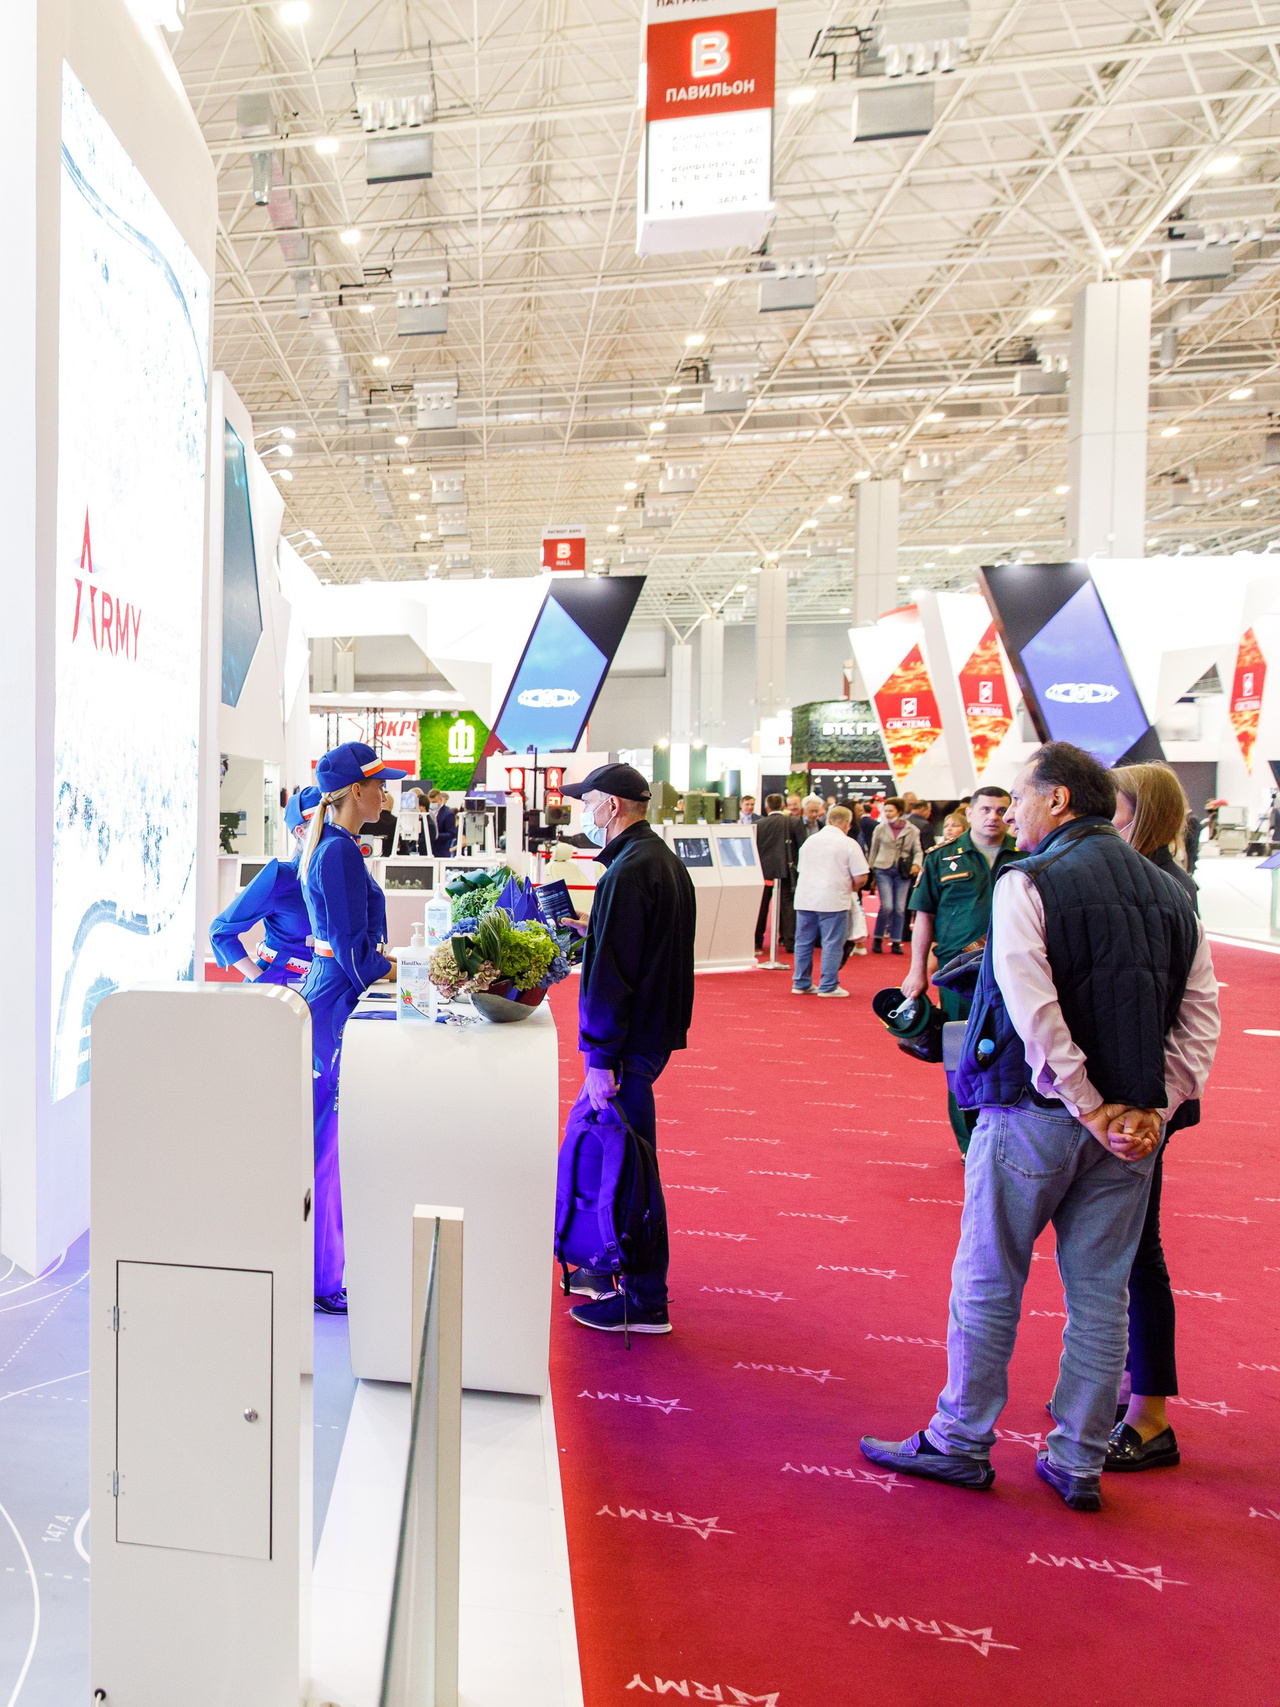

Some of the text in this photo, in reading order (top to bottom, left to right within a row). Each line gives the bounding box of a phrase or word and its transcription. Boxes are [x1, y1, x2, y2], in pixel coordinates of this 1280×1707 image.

[666, 79, 755, 103] ПАВИЛЬОН
[823, 722, 880, 736] БТК ГР
[733, 1361, 847, 1384] ARMY
[577, 1389, 694, 1415] ARMY
[780, 1462, 916, 1493] ARMY
[41, 1514, 74, 1542] 147.4
[596, 1504, 737, 1541] ARMY
[1026, 1552, 1192, 1593] ARMY
[849, 1610, 1021, 1657] ARMY
